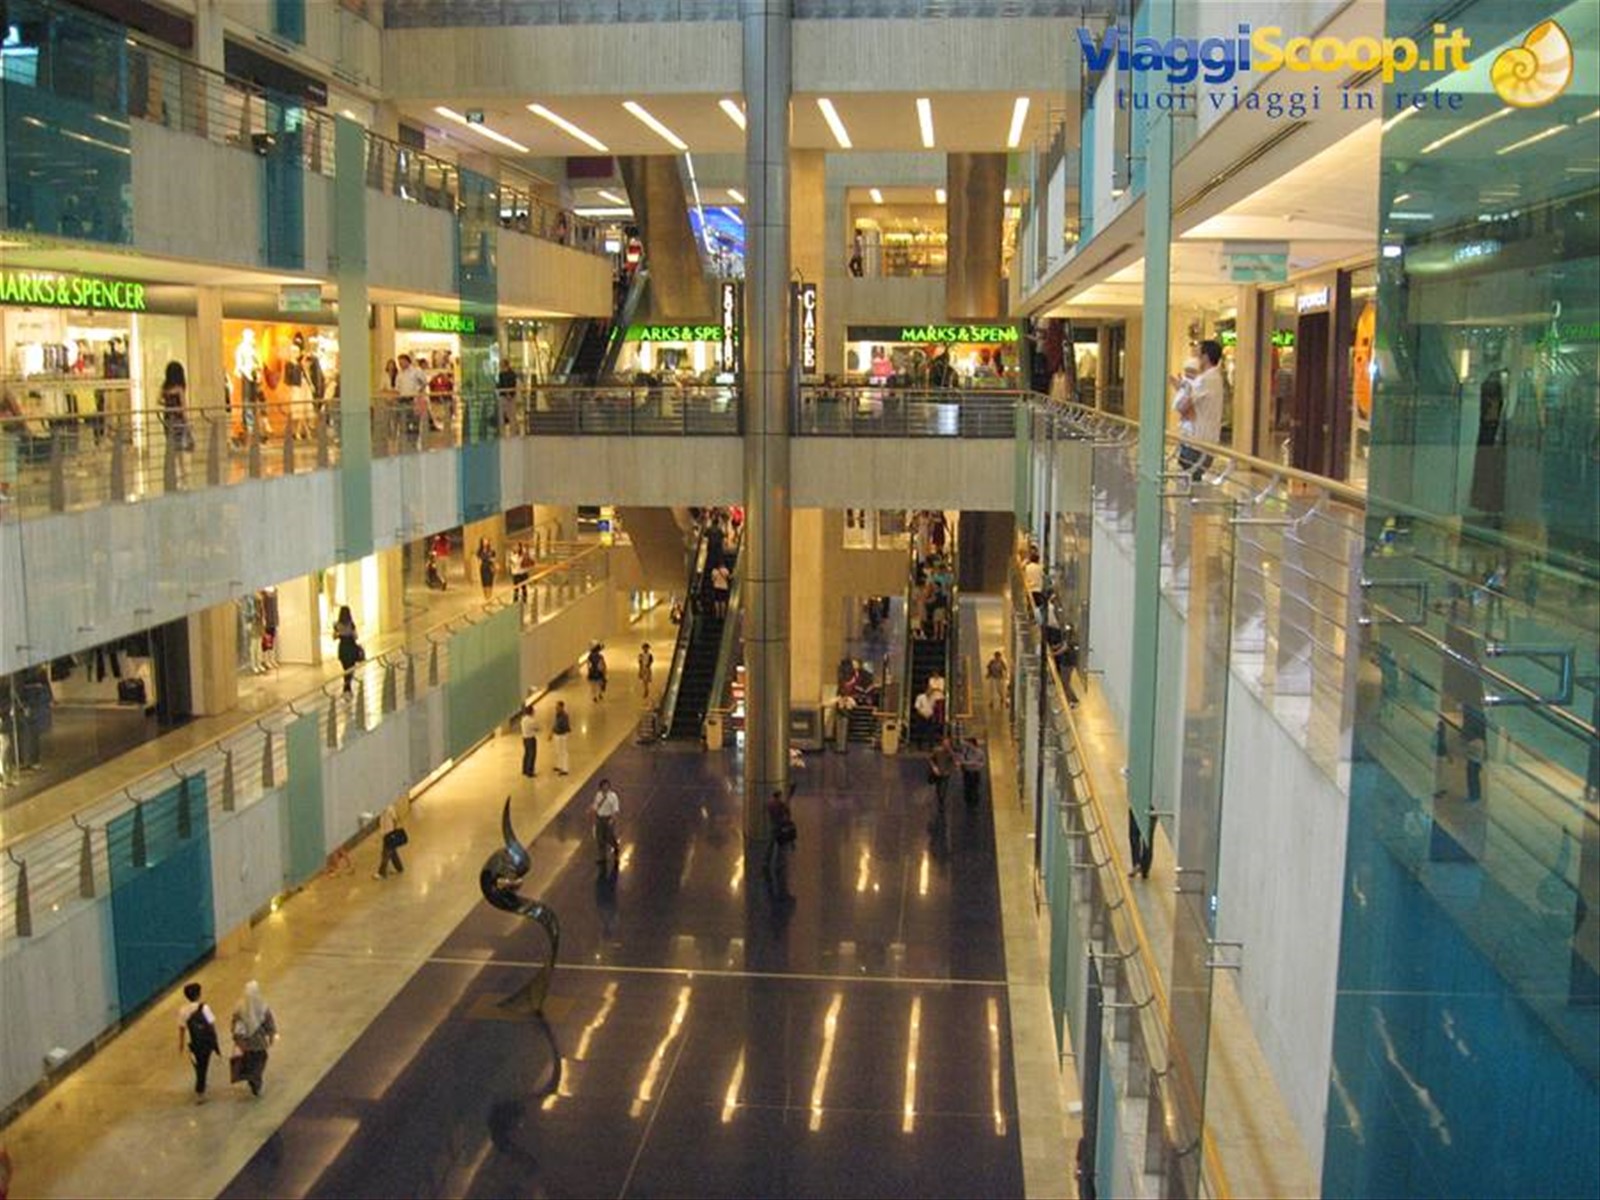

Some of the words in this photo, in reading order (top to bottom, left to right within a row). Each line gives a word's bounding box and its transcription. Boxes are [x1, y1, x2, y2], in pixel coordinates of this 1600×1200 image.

[57, 275, 71, 305] &
[72, 277, 145, 309] SPENCER
[640, 326, 680, 341] ARKS
[681, 326, 692, 341] &
[902, 326, 957, 341] MARKS
[958, 327, 970, 341] &
